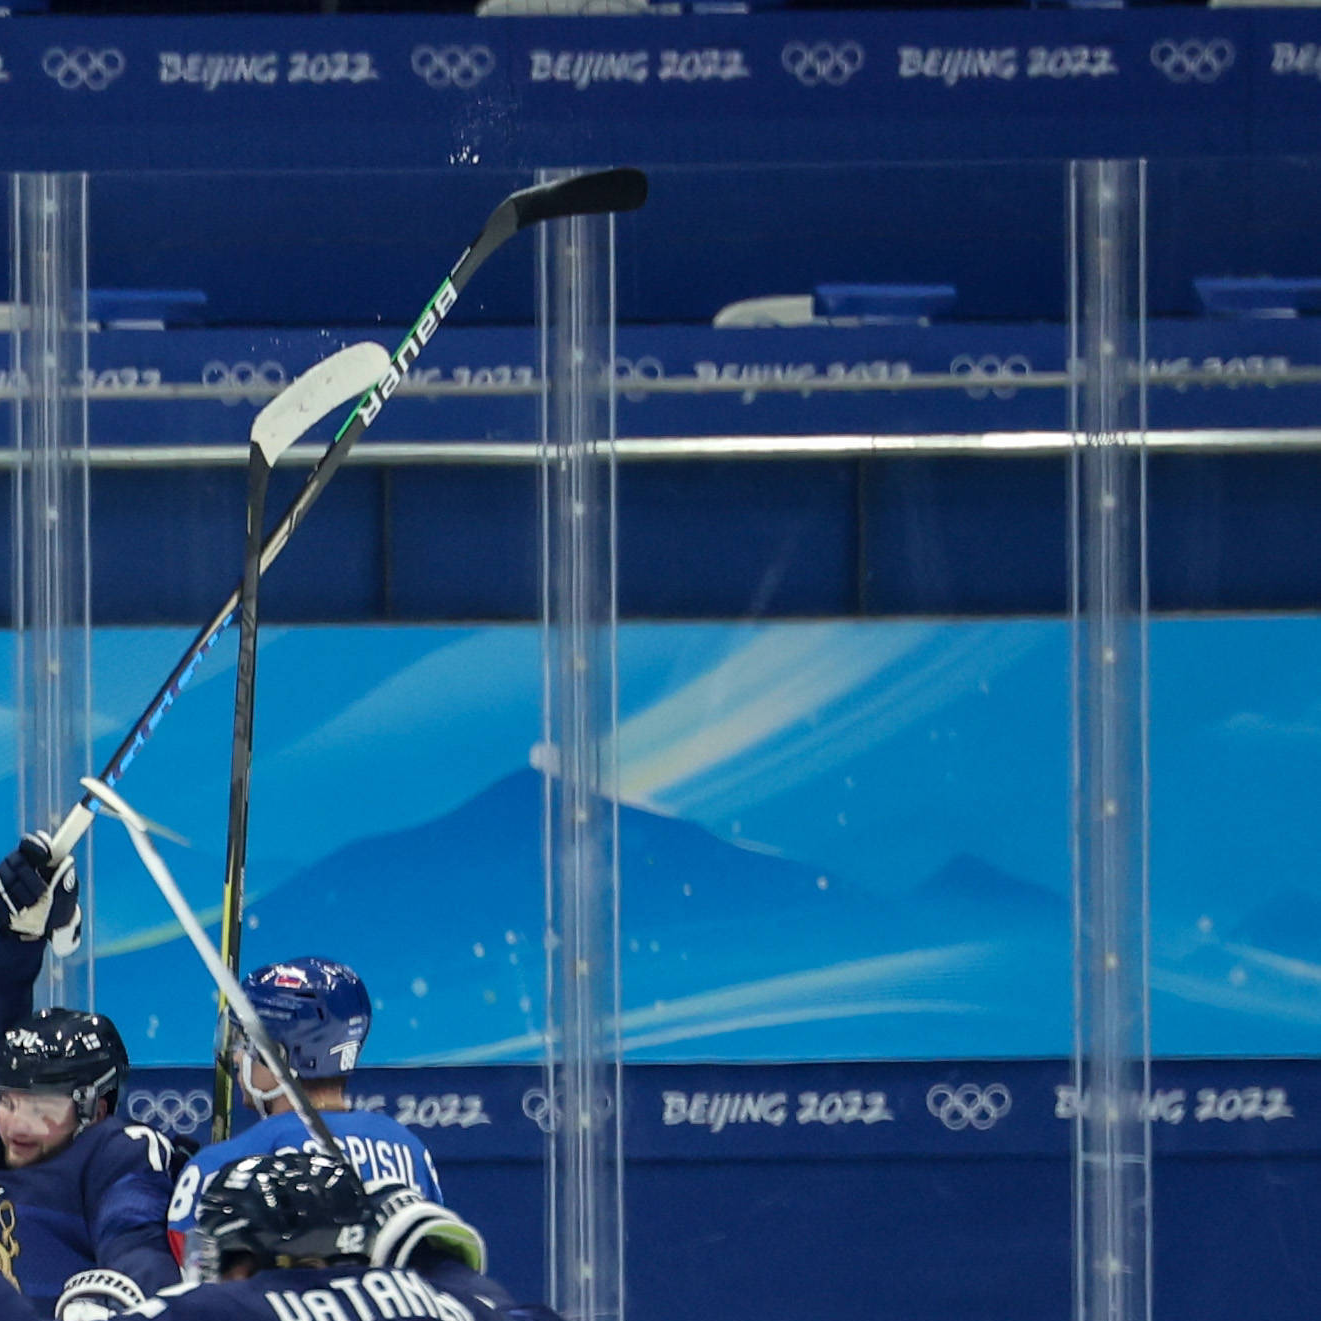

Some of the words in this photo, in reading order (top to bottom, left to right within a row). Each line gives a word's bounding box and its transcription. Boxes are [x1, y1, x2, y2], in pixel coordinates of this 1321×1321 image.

[159, 51, 277, 91] BEIJING
[287, 51, 380, 84] 2022
[529, 48, 648, 91] BEIJING
[658, 49, 751, 81] 2022
[897, 45, 1016, 88] BEIJING
[1026, 46, 1118, 79] 2022
[393, 1093, 492, 1129] 2022
[661, 1090, 789, 1133] BEIJING
[797, 1091, 894, 1125] 2022
[1194, 1086, 1294, 1123] 2022
[335, 1224, 365, 1253] 42
